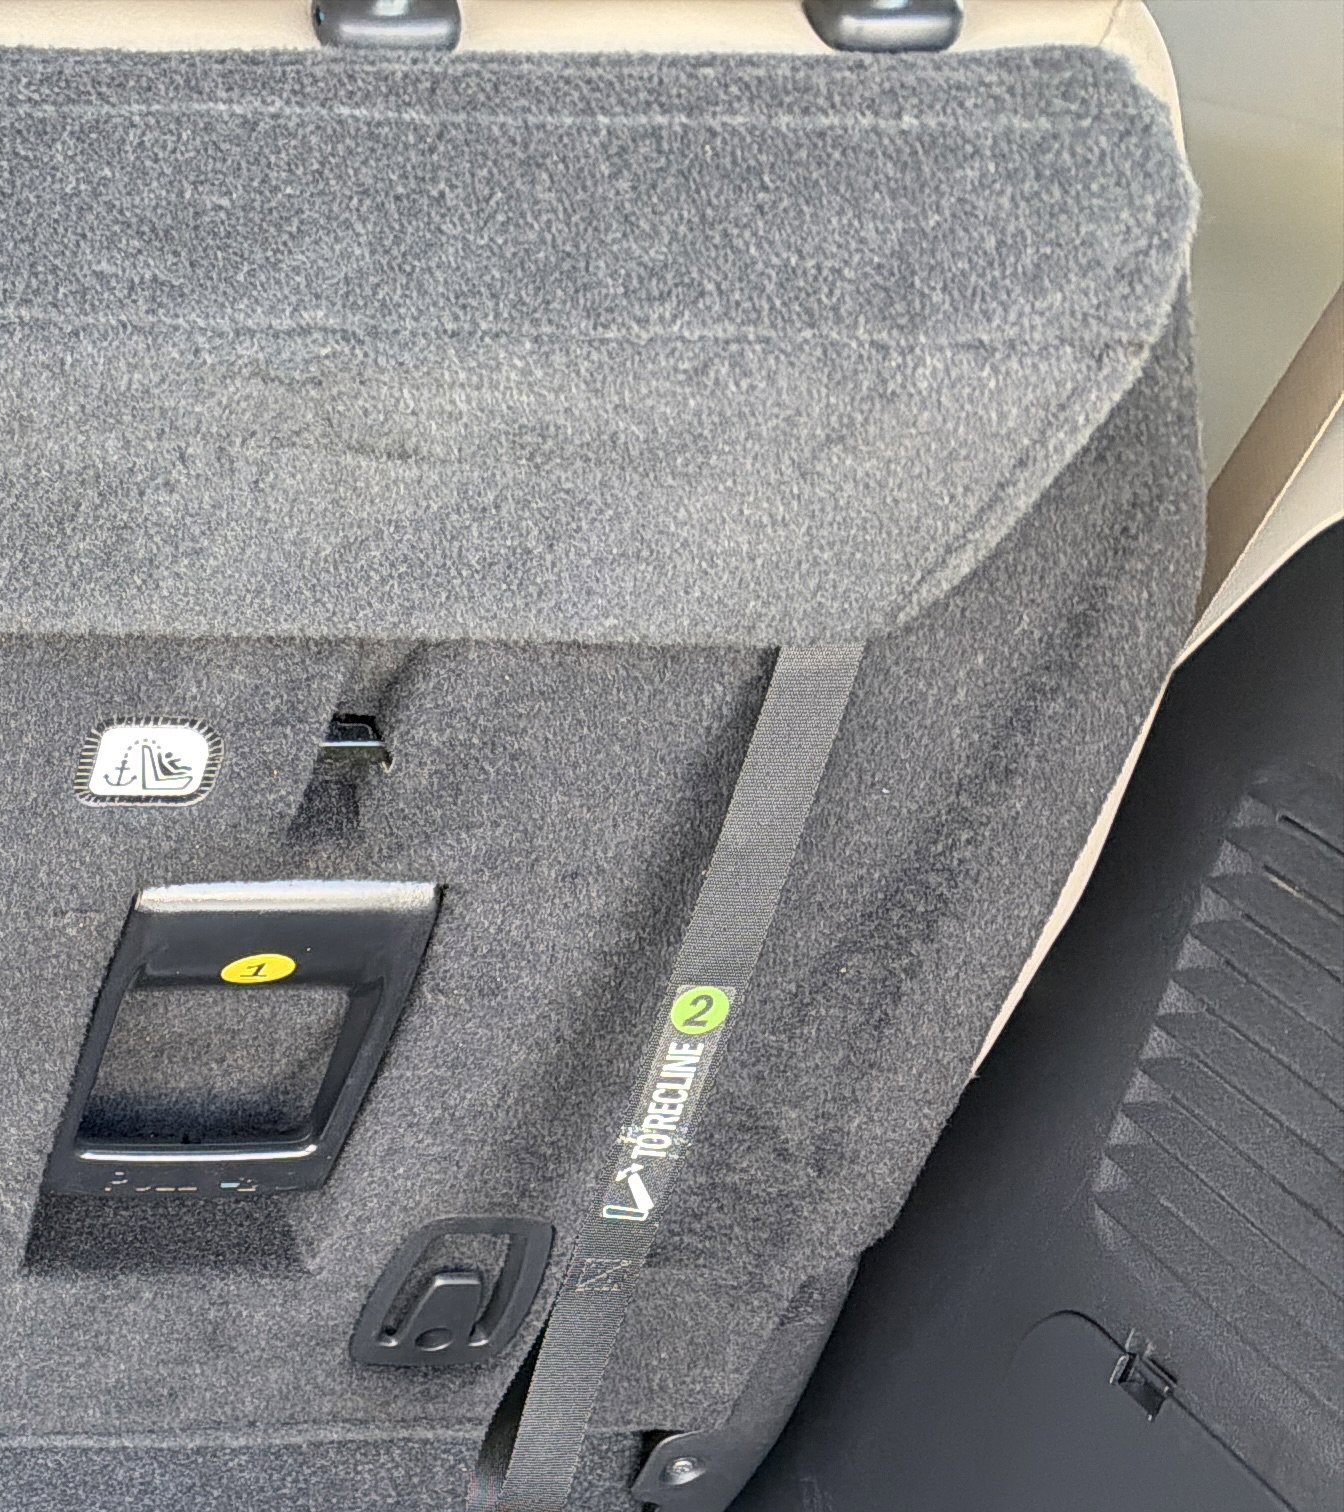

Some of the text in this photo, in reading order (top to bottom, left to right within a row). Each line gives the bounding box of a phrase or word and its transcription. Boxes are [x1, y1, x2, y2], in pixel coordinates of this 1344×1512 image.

[682, 994, 713, 1027] 2
[631, 1041, 705, 1159] TO RECLINE
